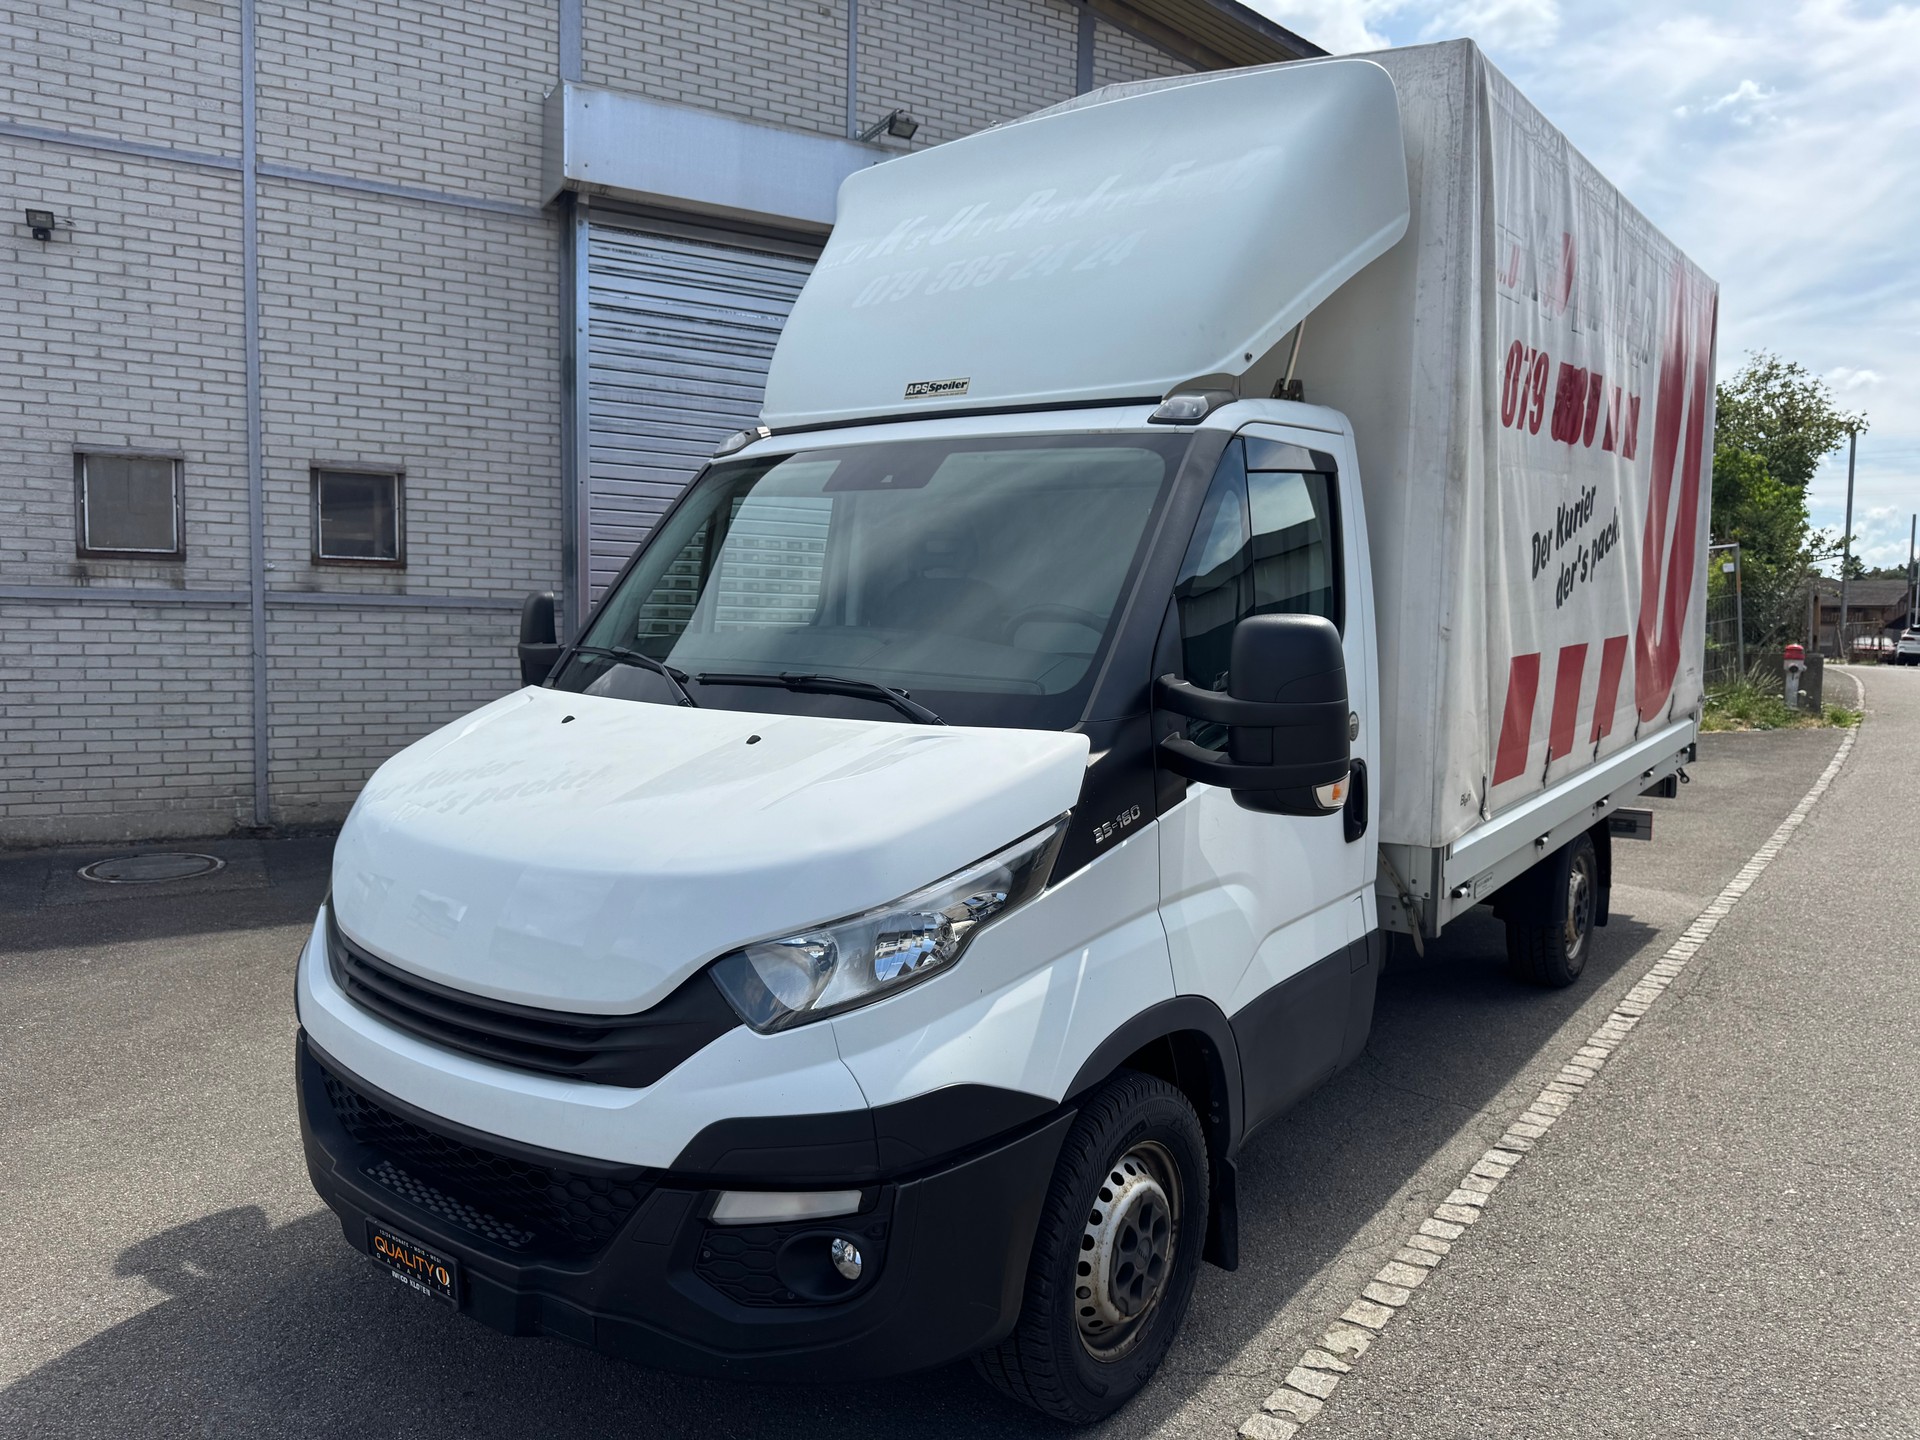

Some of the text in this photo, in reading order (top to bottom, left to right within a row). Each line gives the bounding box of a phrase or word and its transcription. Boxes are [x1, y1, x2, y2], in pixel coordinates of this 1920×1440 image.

[852, 267, 930, 308] 079
[925, 251, 1015, 296] 585
[1501, 339, 1550, 435] 079
[1532, 528, 1553, 580] Der
[1556, 484, 1596, 551] Kurier
[1556, 544, 1589, 609] der's
[1092, 804, 1141, 844] 35-160
[374, 1235, 434, 1277] QUALITY
[376, 1252, 451, 1296] GARANTIE
